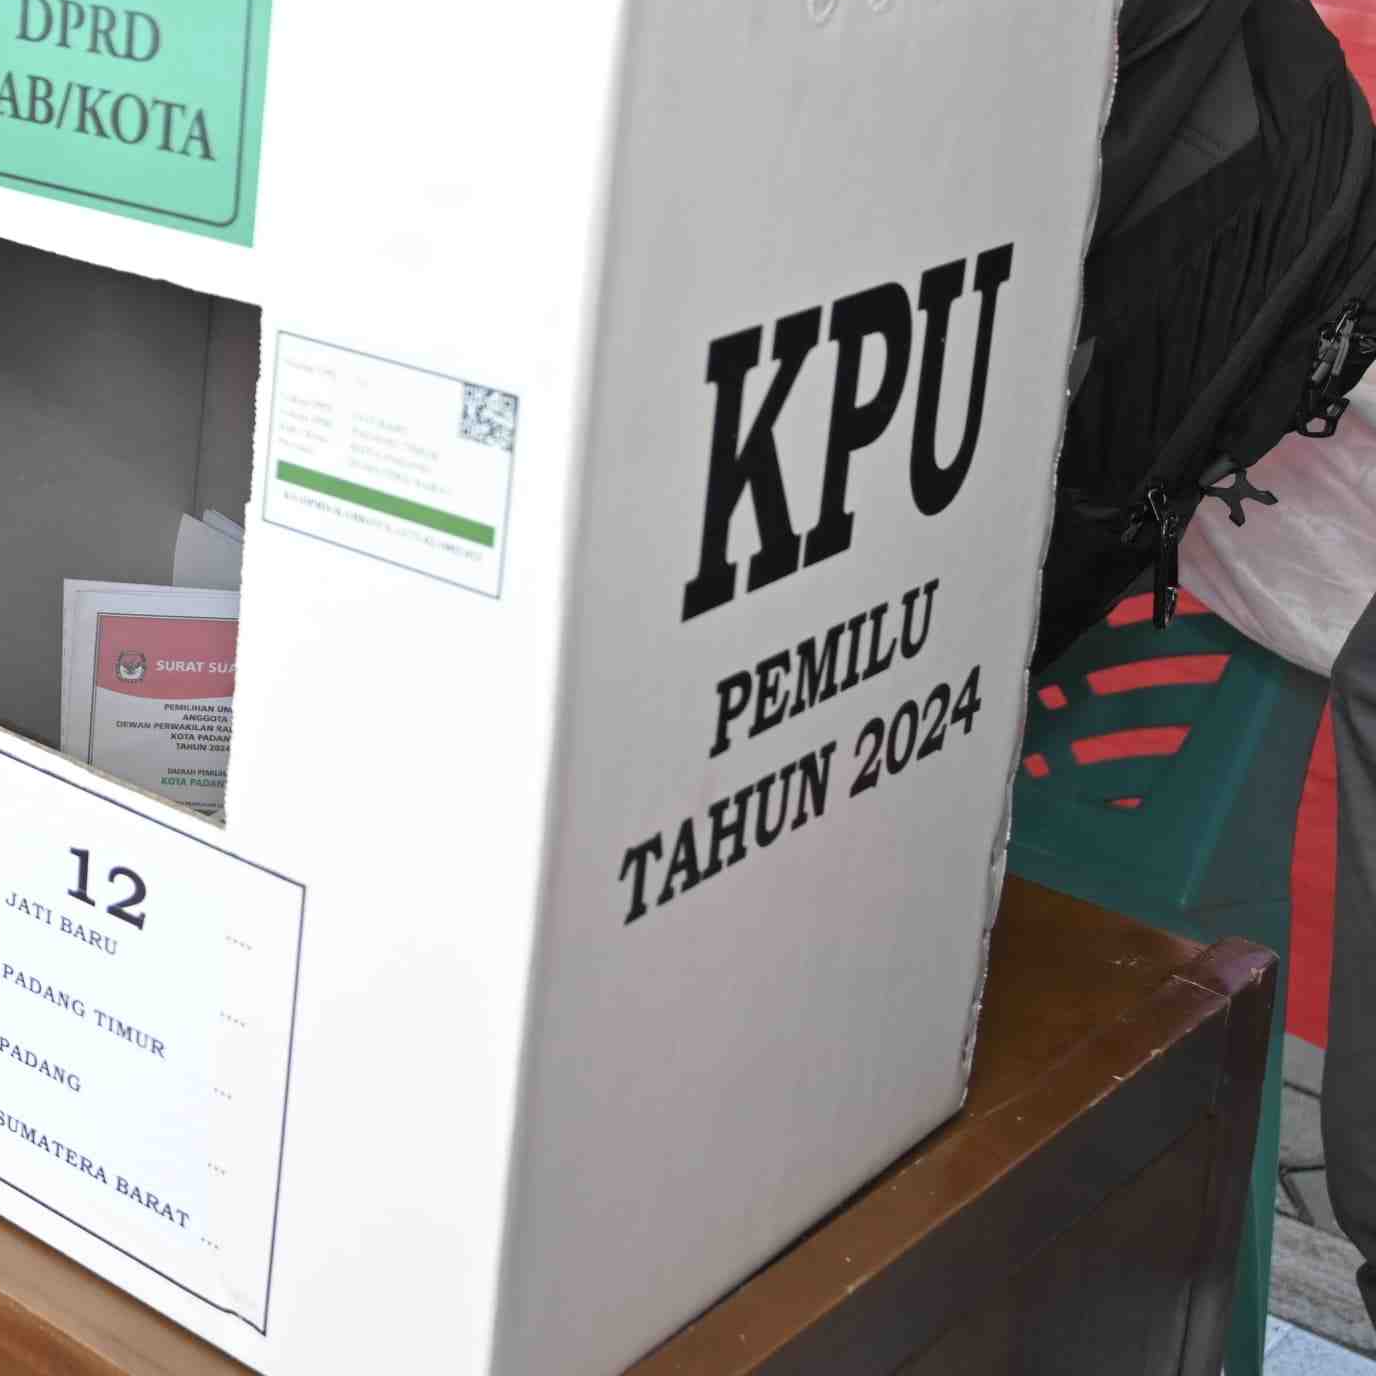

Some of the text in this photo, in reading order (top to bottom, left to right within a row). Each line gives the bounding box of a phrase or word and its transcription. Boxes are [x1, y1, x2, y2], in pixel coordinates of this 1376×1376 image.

[680, 242, 1014, 622] KPU
[155, 659, 203, 673] SURAT
[709, 578, 940, 759] PEMILU
[164, 704, 214, 713] PEMILIHAN
[182, 714, 228, 722] ANGGOTA
[116, 721, 152, 729] DEWAN
[153, 722, 214, 732] PERWAKILAN
[170, 733, 195, 741] KOTA
[176, 743, 207, 752] TAHUN
[160, 777, 186, 785] KOTA
[618, 664, 981, 926] TAHUN 2024
[66, 846, 147, 932] 12
[5, 891, 119, 957] JATI BARU
[2, 962, 166, 1060] PADANG TIMUR
[115, 1173, 190, 1230] BARAT
